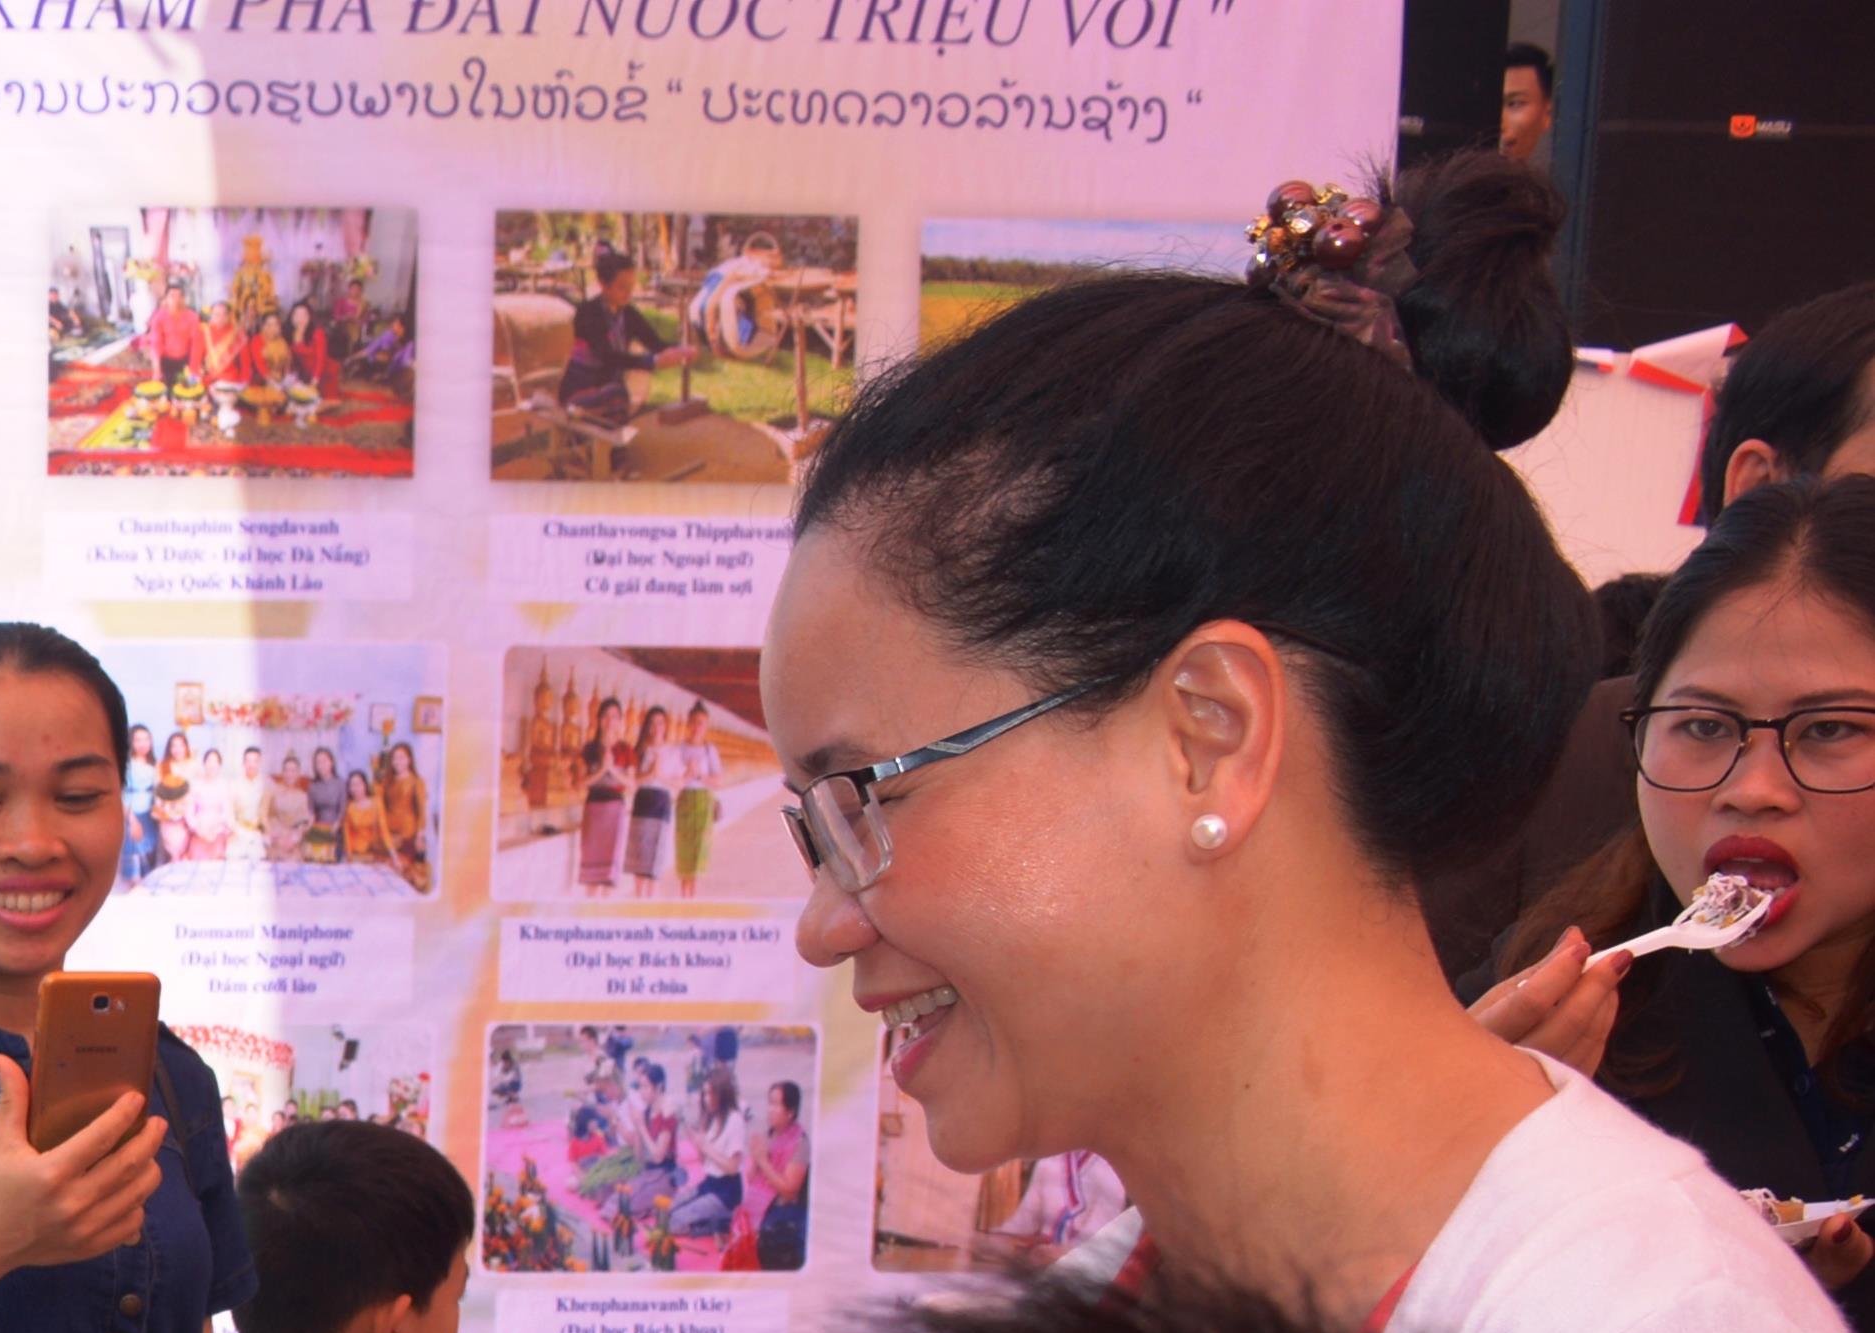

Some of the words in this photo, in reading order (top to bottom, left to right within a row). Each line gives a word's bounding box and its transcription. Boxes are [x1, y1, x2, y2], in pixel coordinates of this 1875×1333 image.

[239, 519, 340, 538] Sengdavanh
[543, 522, 677, 542] Chanthavongsa
[145, 546, 155, 562] Y
[257, 546, 286, 563] học
[627, 550, 655, 568] học
[261, 924, 355, 944] Maniphone
[519, 924, 654, 945] Khenphanavanh
[658, 924, 737, 943] Soukanya
[221, 951, 250, 967] học
[605, 952, 634, 970] học
[639, 952, 681, 968] Bách
[685, 952, 733, 969] khoa)
[555, 1297, 689, 1315] Khenphanavanh
